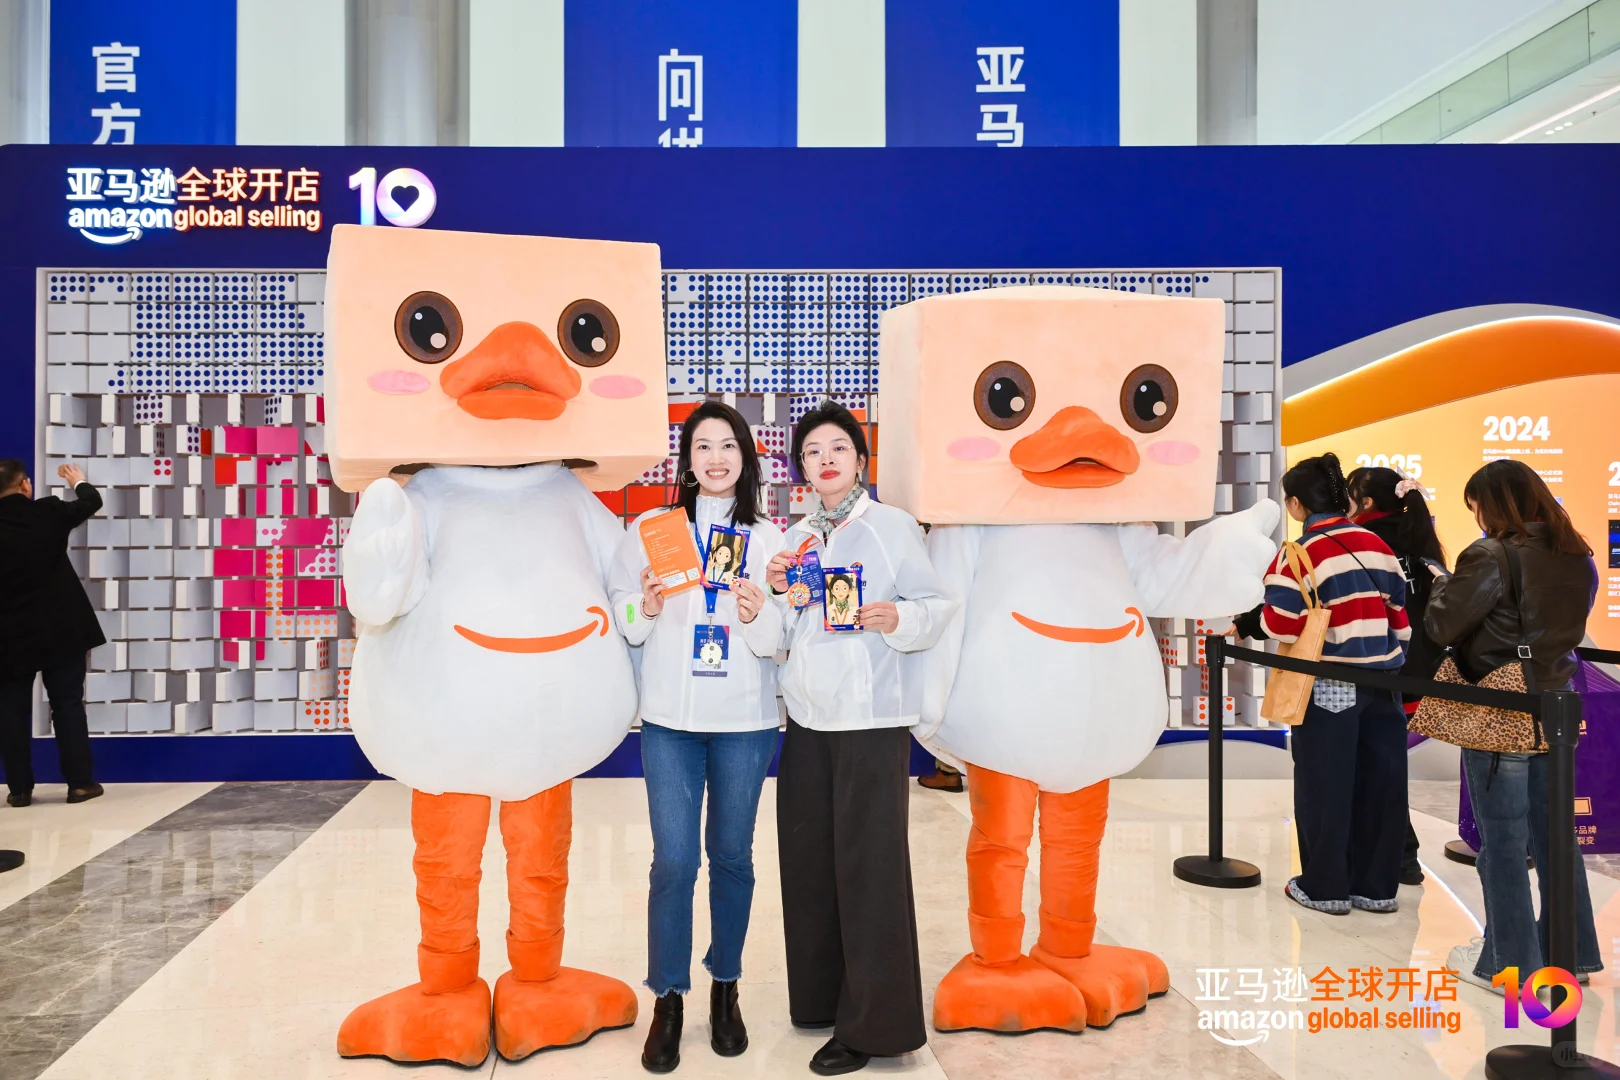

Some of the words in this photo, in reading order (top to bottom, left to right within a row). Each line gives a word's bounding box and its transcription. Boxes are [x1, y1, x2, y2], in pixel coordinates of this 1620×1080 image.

[91, 42, 141, 145] 官方
[976, 46, 1025, 147] 亚马
[66, 166, 320, 205] 亚马逊全球开店
[68, 206, 173, 231] amazon
[173, 205, 243, 231] global
[247, 205, 321, 231] selling
[1483, 415, 1551, 441] 2024
